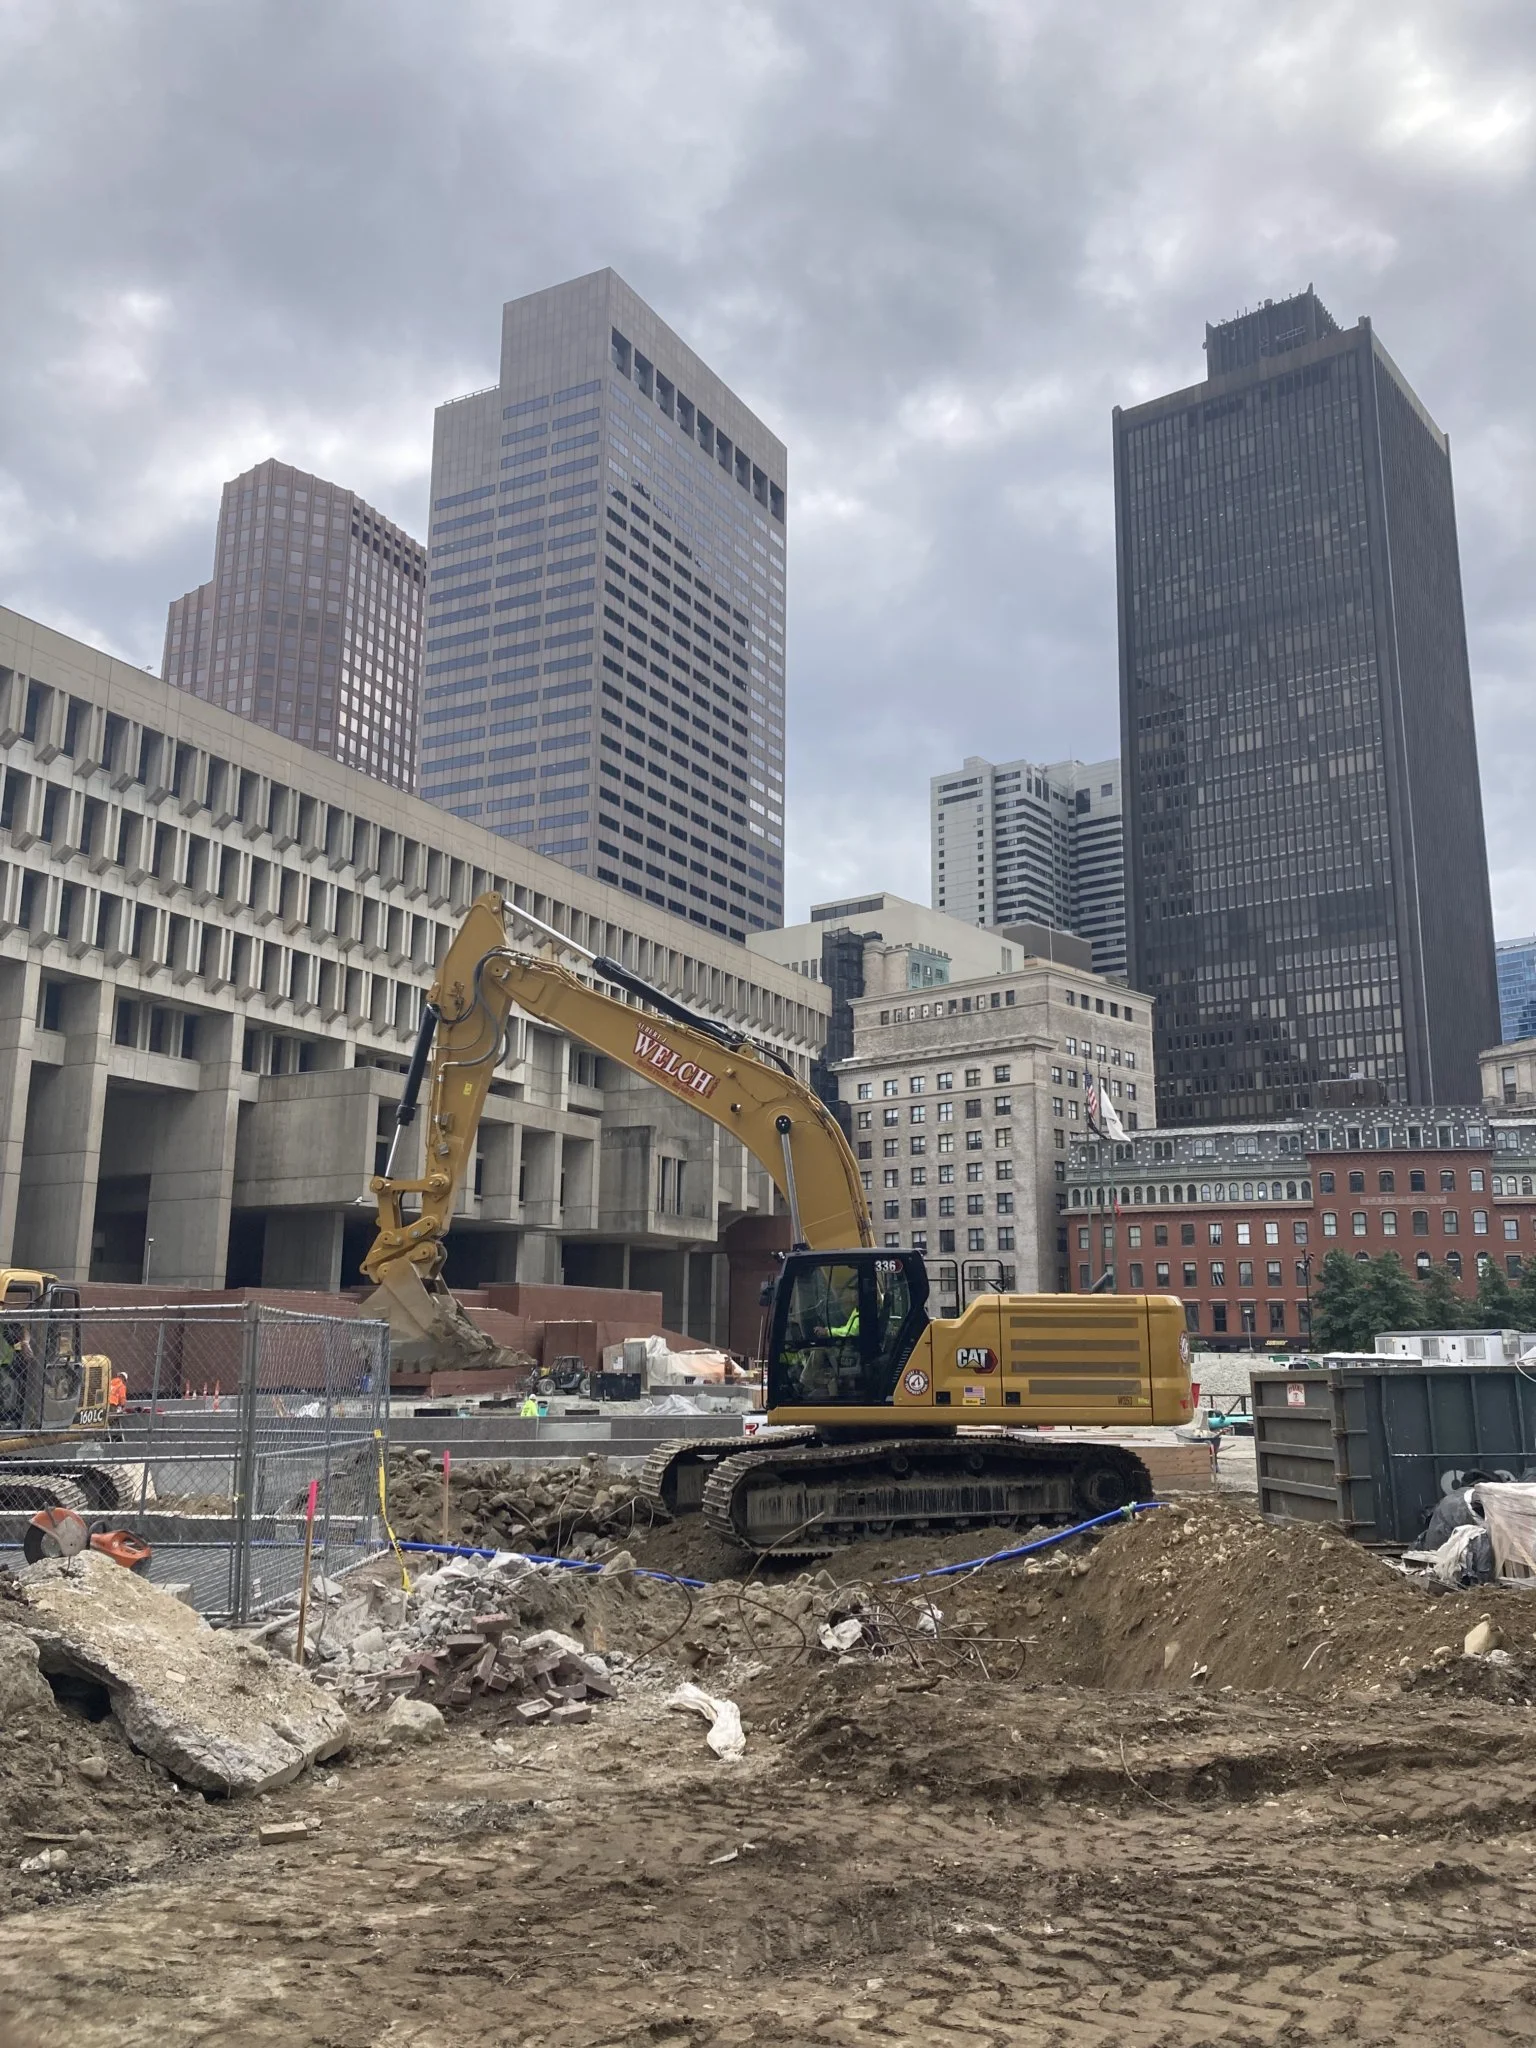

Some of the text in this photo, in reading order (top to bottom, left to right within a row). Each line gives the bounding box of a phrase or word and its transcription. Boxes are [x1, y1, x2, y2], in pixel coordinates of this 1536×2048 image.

[633, 1030, 715, 1096] WELCH
[875, 1260, 896, 1272] 336
[957, 1348, 988, 1368] CAT
